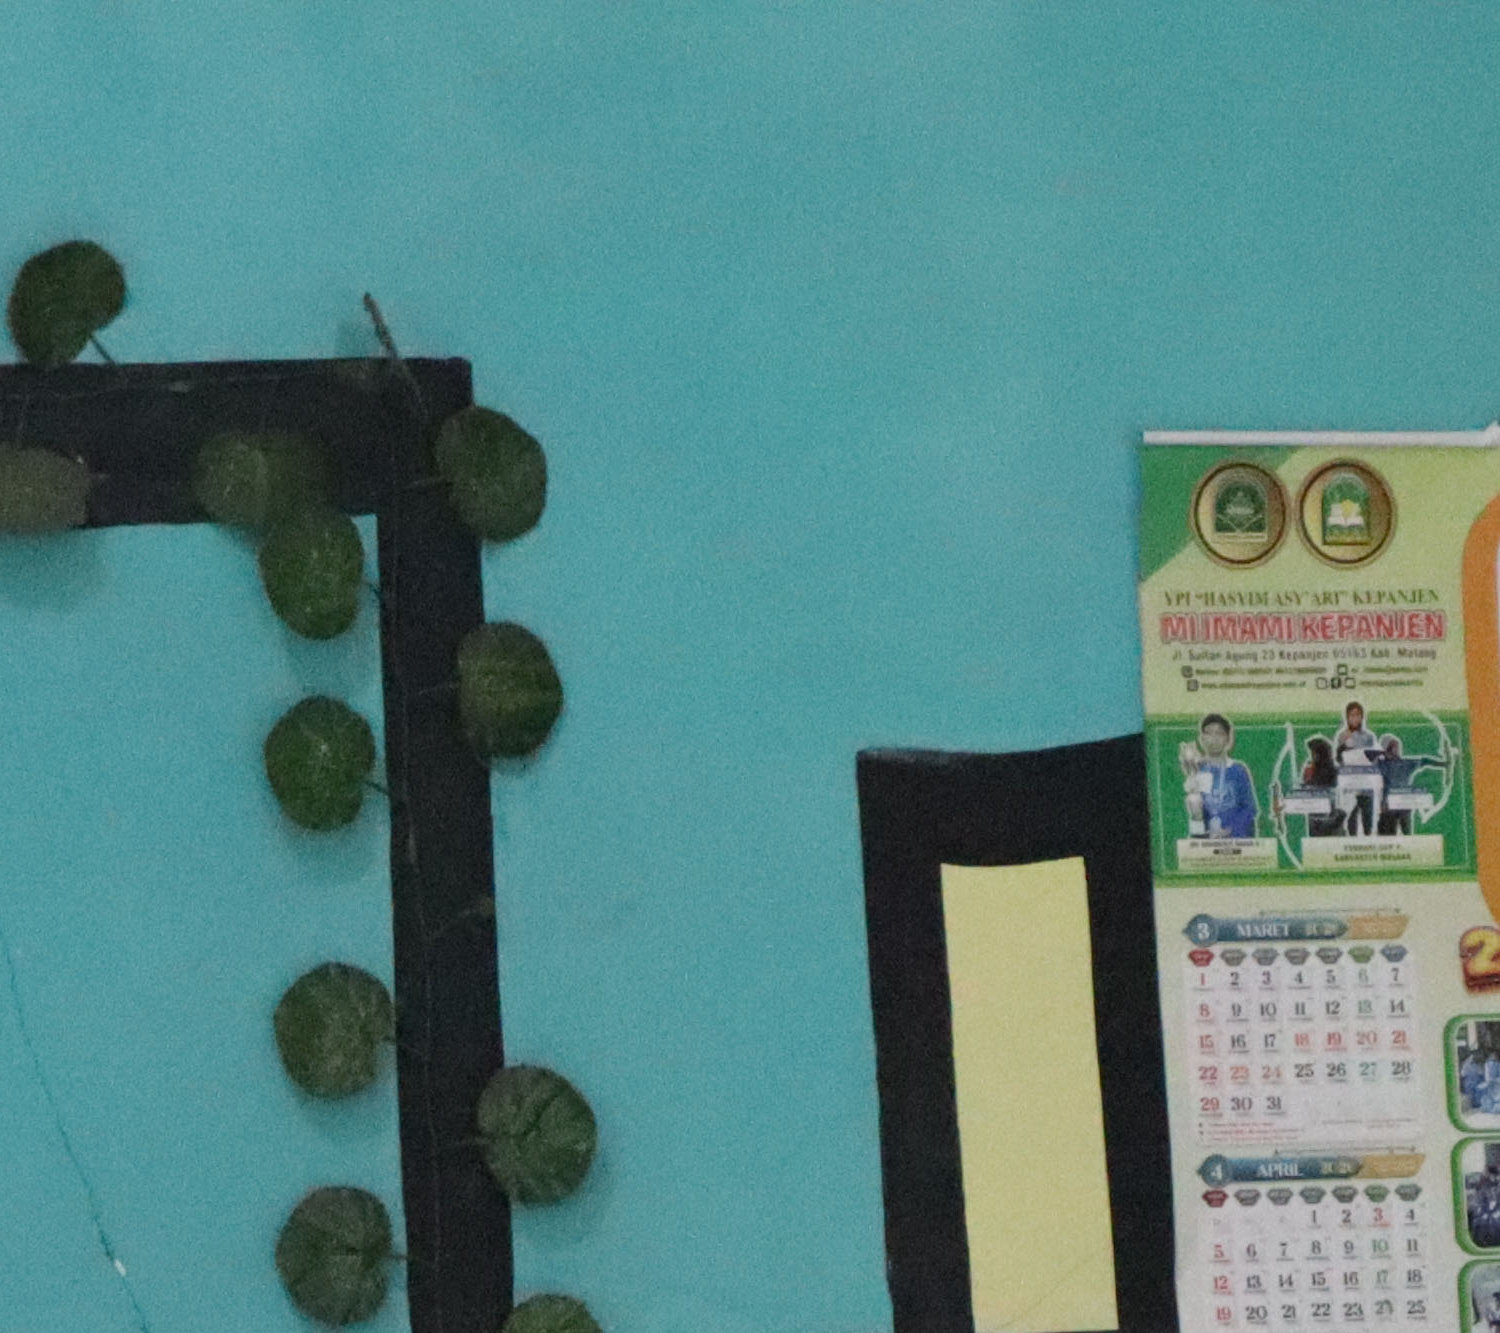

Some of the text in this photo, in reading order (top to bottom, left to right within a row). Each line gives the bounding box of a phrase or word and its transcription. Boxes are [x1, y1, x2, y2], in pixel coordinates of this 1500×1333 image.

[1161, 610, 1446, 643] MI IMAMI KEPANJEN
[1197, 922, 1211, 939] 3
[1236, 922, 1290, 937] MARET
[1200, 972, 1205, 985] 1
[1230, 973, 1239, 986] 2
[1262, 972, 1271, 985] 3
[1294, 971, 1303, 984] 4
[1326, 970, 1336, 983] 5
[1391, 968, 1399, 981] 7
[1231, 1004, 1241, 1017] 9
[1260, 1003, 1277, 1016] 10
[1295, 1003, 1305, 1015] 11
[1325, 1002, 1340, 1015] 12
[1358, 1001, 1372, 1014] 13
[1390, 999, 1405, 1013] 14
[1199, 1031, 1406, 1049] 15 16 17 18 19 20 21
[1198, 1062, 1411, 1080] 22 23 24 25 26 27 28
[1200, 1097, 1282, 1111] 29 30 31
[1211, 1164, 1223, 1180] 4
[1257, 1164, 1303, 1177] APRIL
[1311, 1208, 1415, 1223] 1 2 3 4
[1214, 1239, 1418, 1258] 5 6 7 8 9 10 11
[1213, 1270, 1422, 1290] 12 13 14 15 16 17 18
[1216, 1307, 1231, 1320] 19
[1246, 1307, 1267, 1320] 20
[1282, 1306, 1296, 1319] 21
[1312, 1305, 1331, 1317] 22
[1343, 1304, 1363, 1316] 23
[1407, 1301, 1426, 1314] 25
